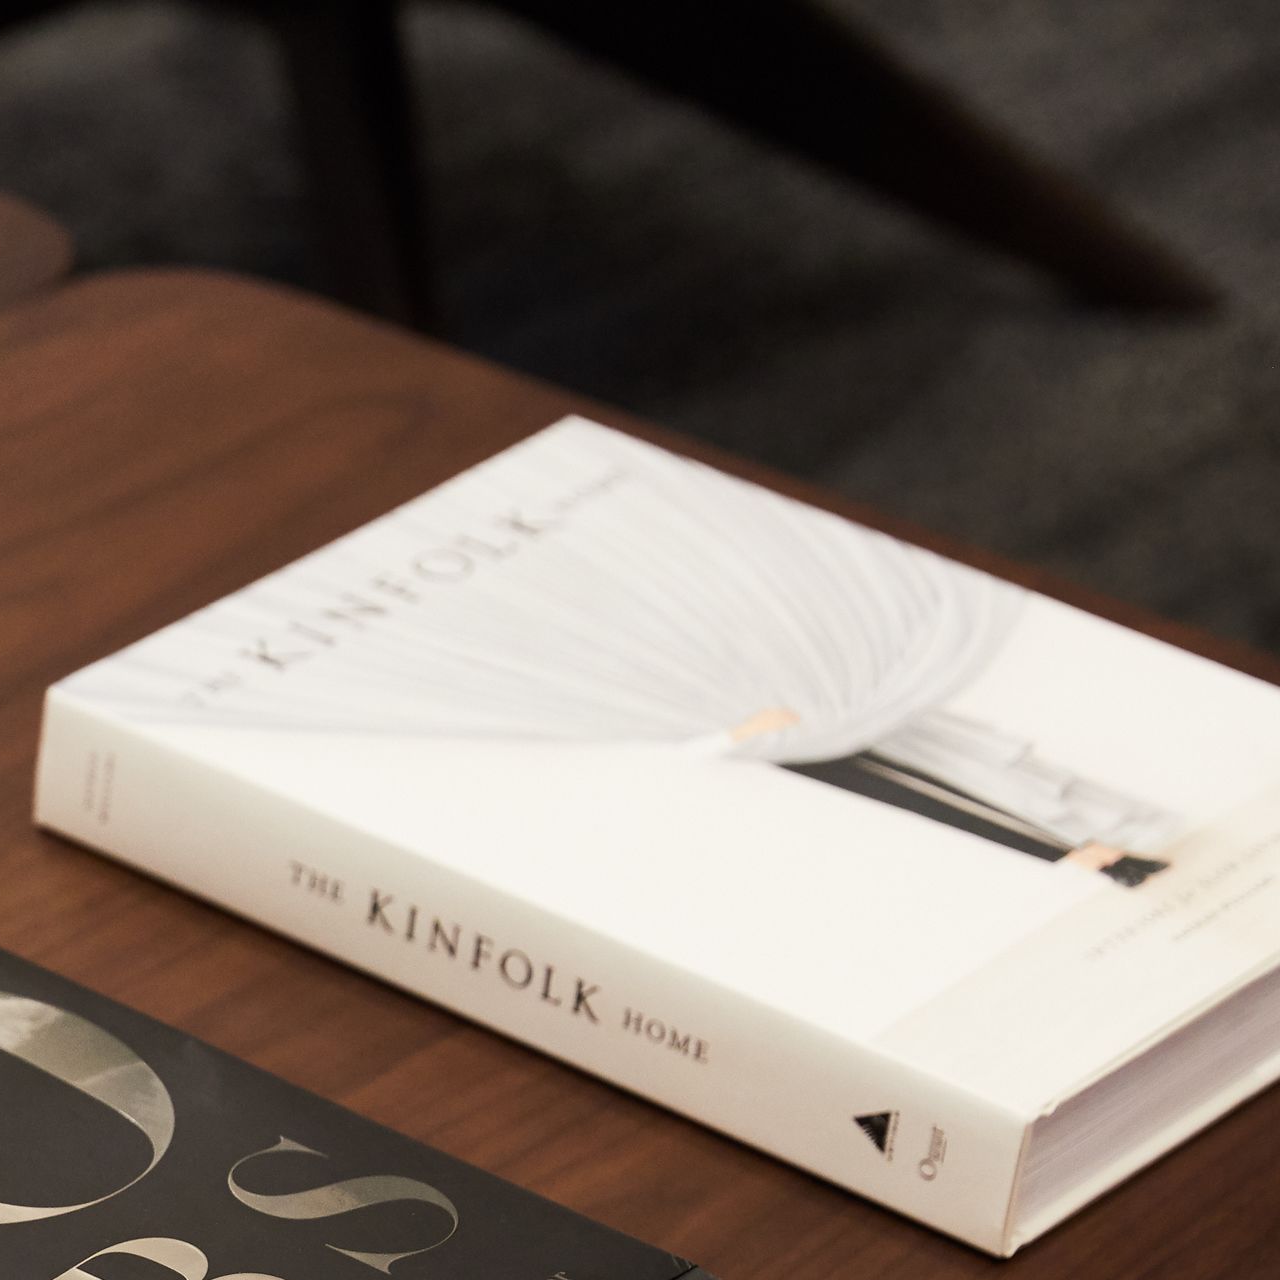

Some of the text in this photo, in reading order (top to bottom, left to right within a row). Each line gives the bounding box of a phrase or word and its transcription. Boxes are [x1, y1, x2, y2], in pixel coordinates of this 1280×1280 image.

[238, 506, 558, 672] KINFOLK
[289, 860, 711, 1064] THE KINFOLK HOME
